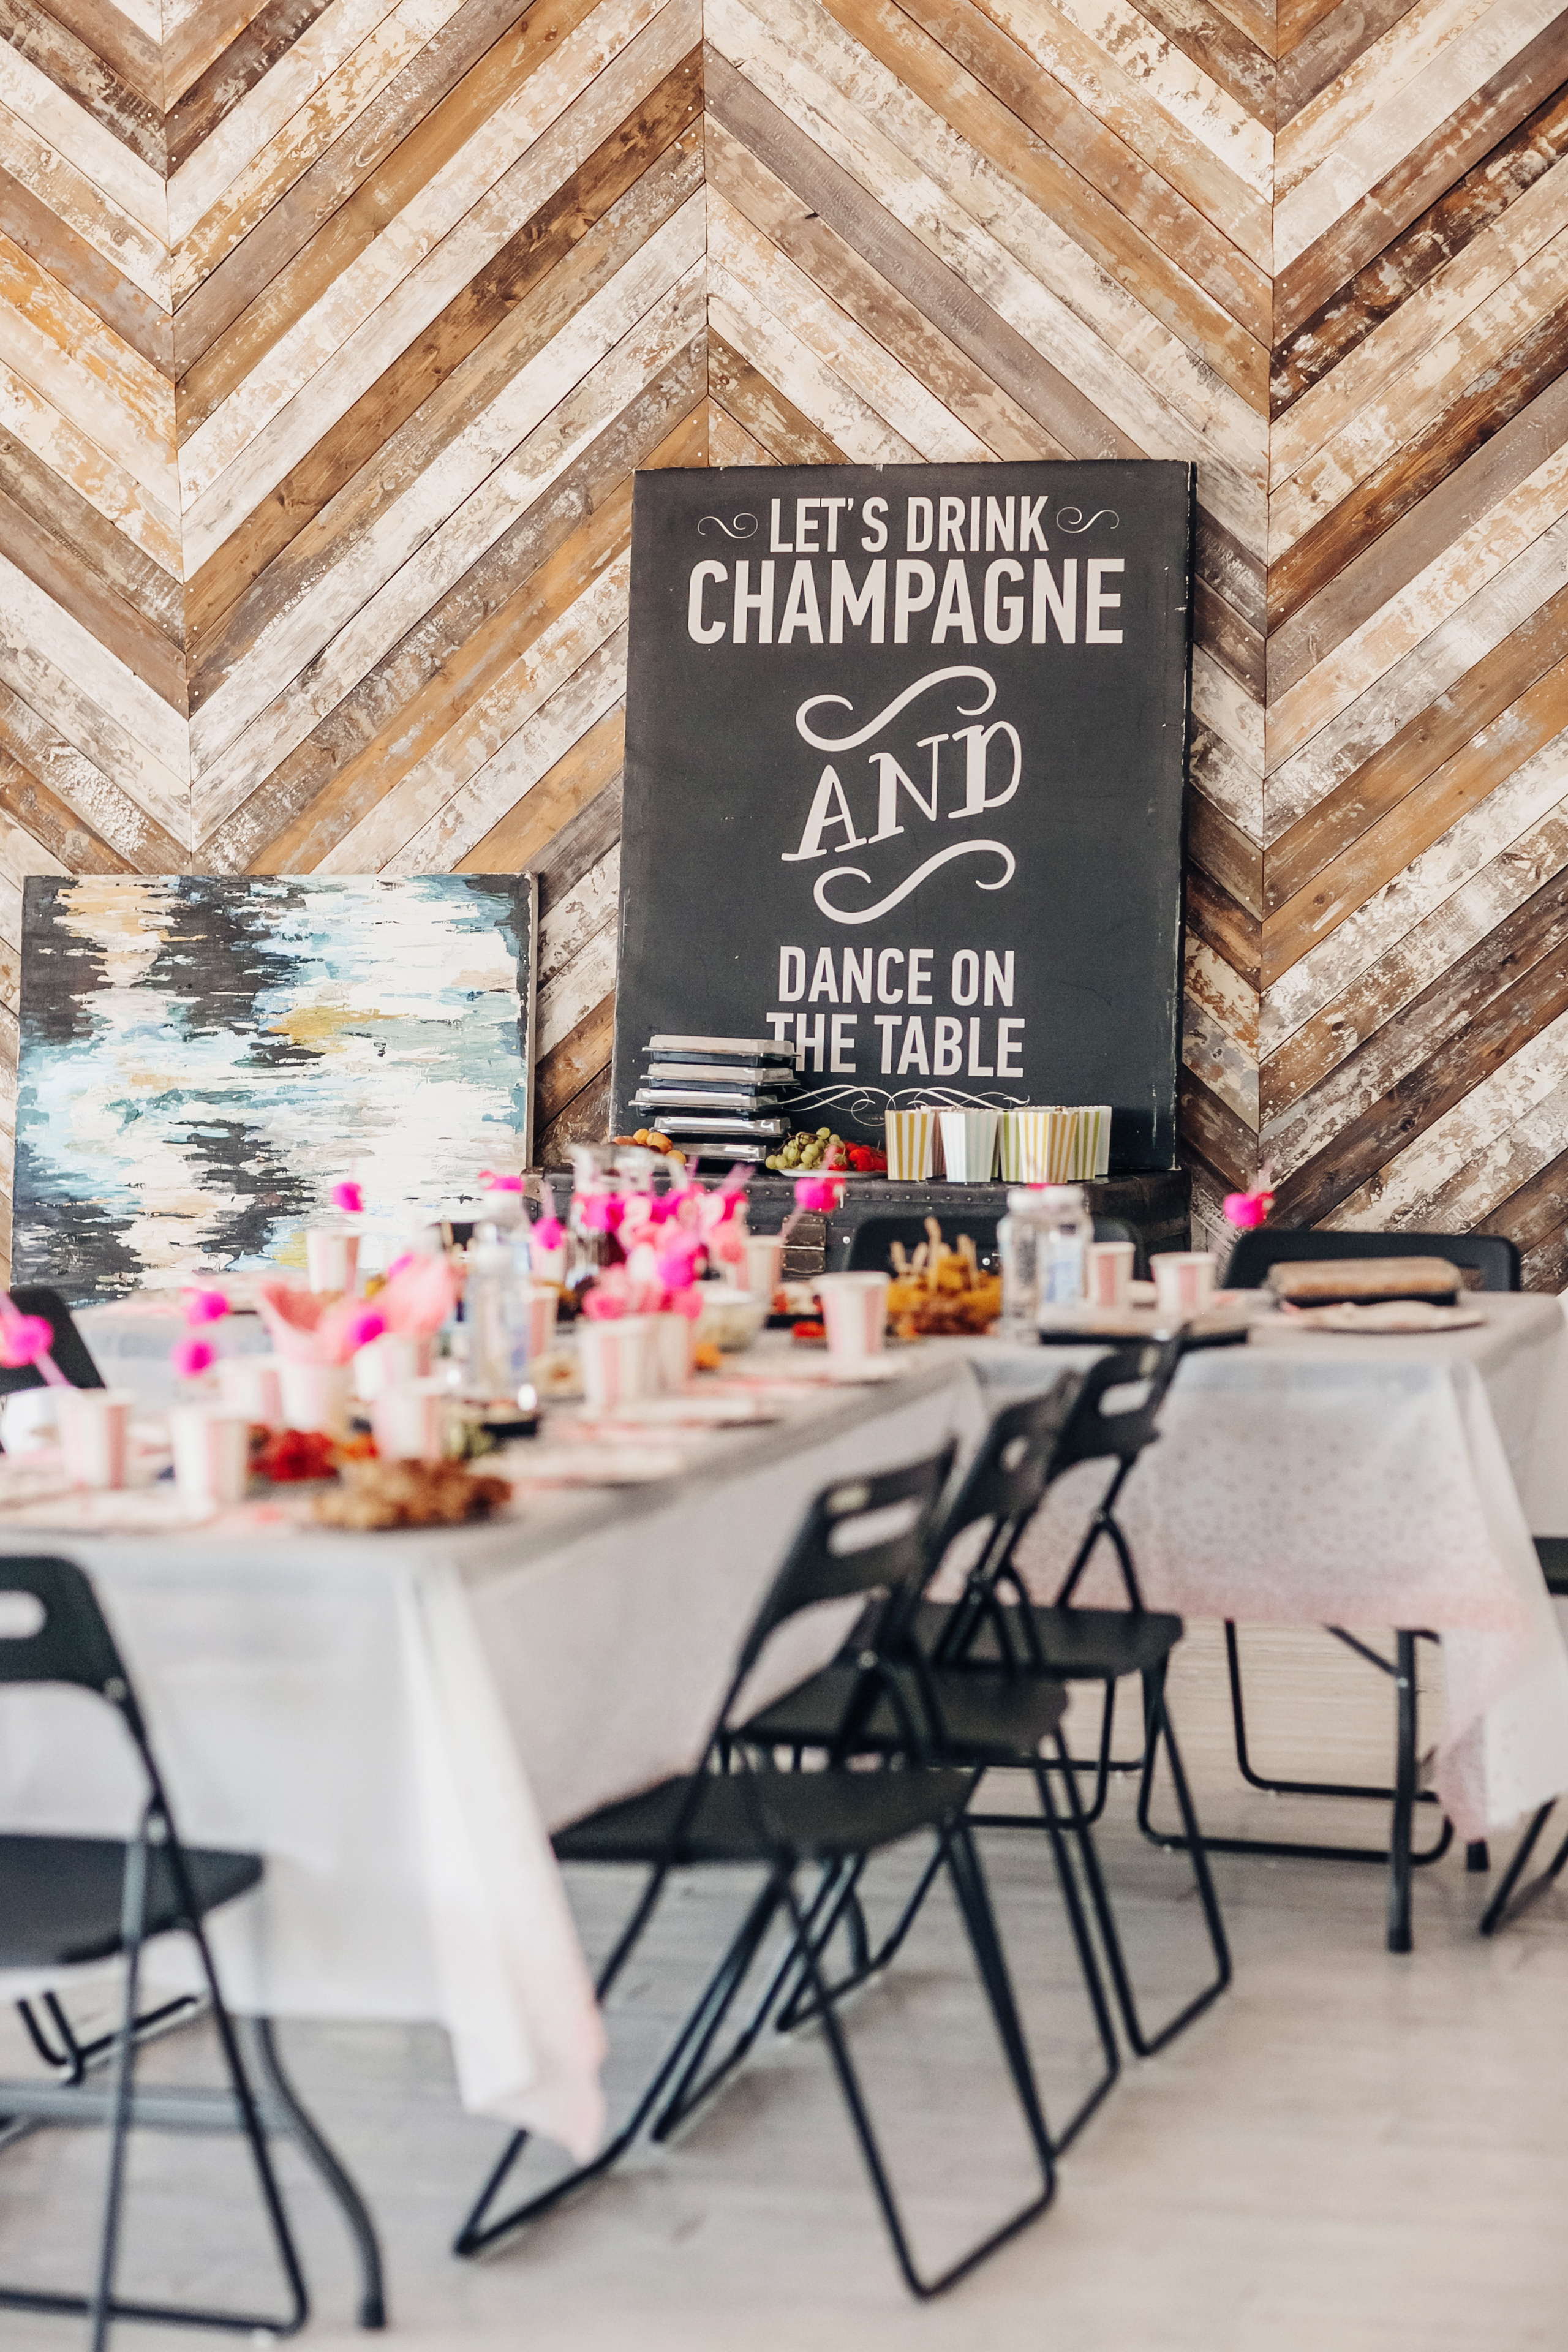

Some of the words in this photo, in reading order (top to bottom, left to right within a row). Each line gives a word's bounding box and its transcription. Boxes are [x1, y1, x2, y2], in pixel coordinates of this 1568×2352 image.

[769, 497, 889, 552] LET'S
[907, 496, 1049, 552] DRINK
[687, 558, 1125, 644] CHAMPAGNE
[781, 720, 1022, 861] AND
[778, 946, 934, 1005] DANCE
[951, 949, 1015, 1007] ON
[766, 1012, 858, 1073] THE
[873, 1014, 1026, 1078] TABLE
